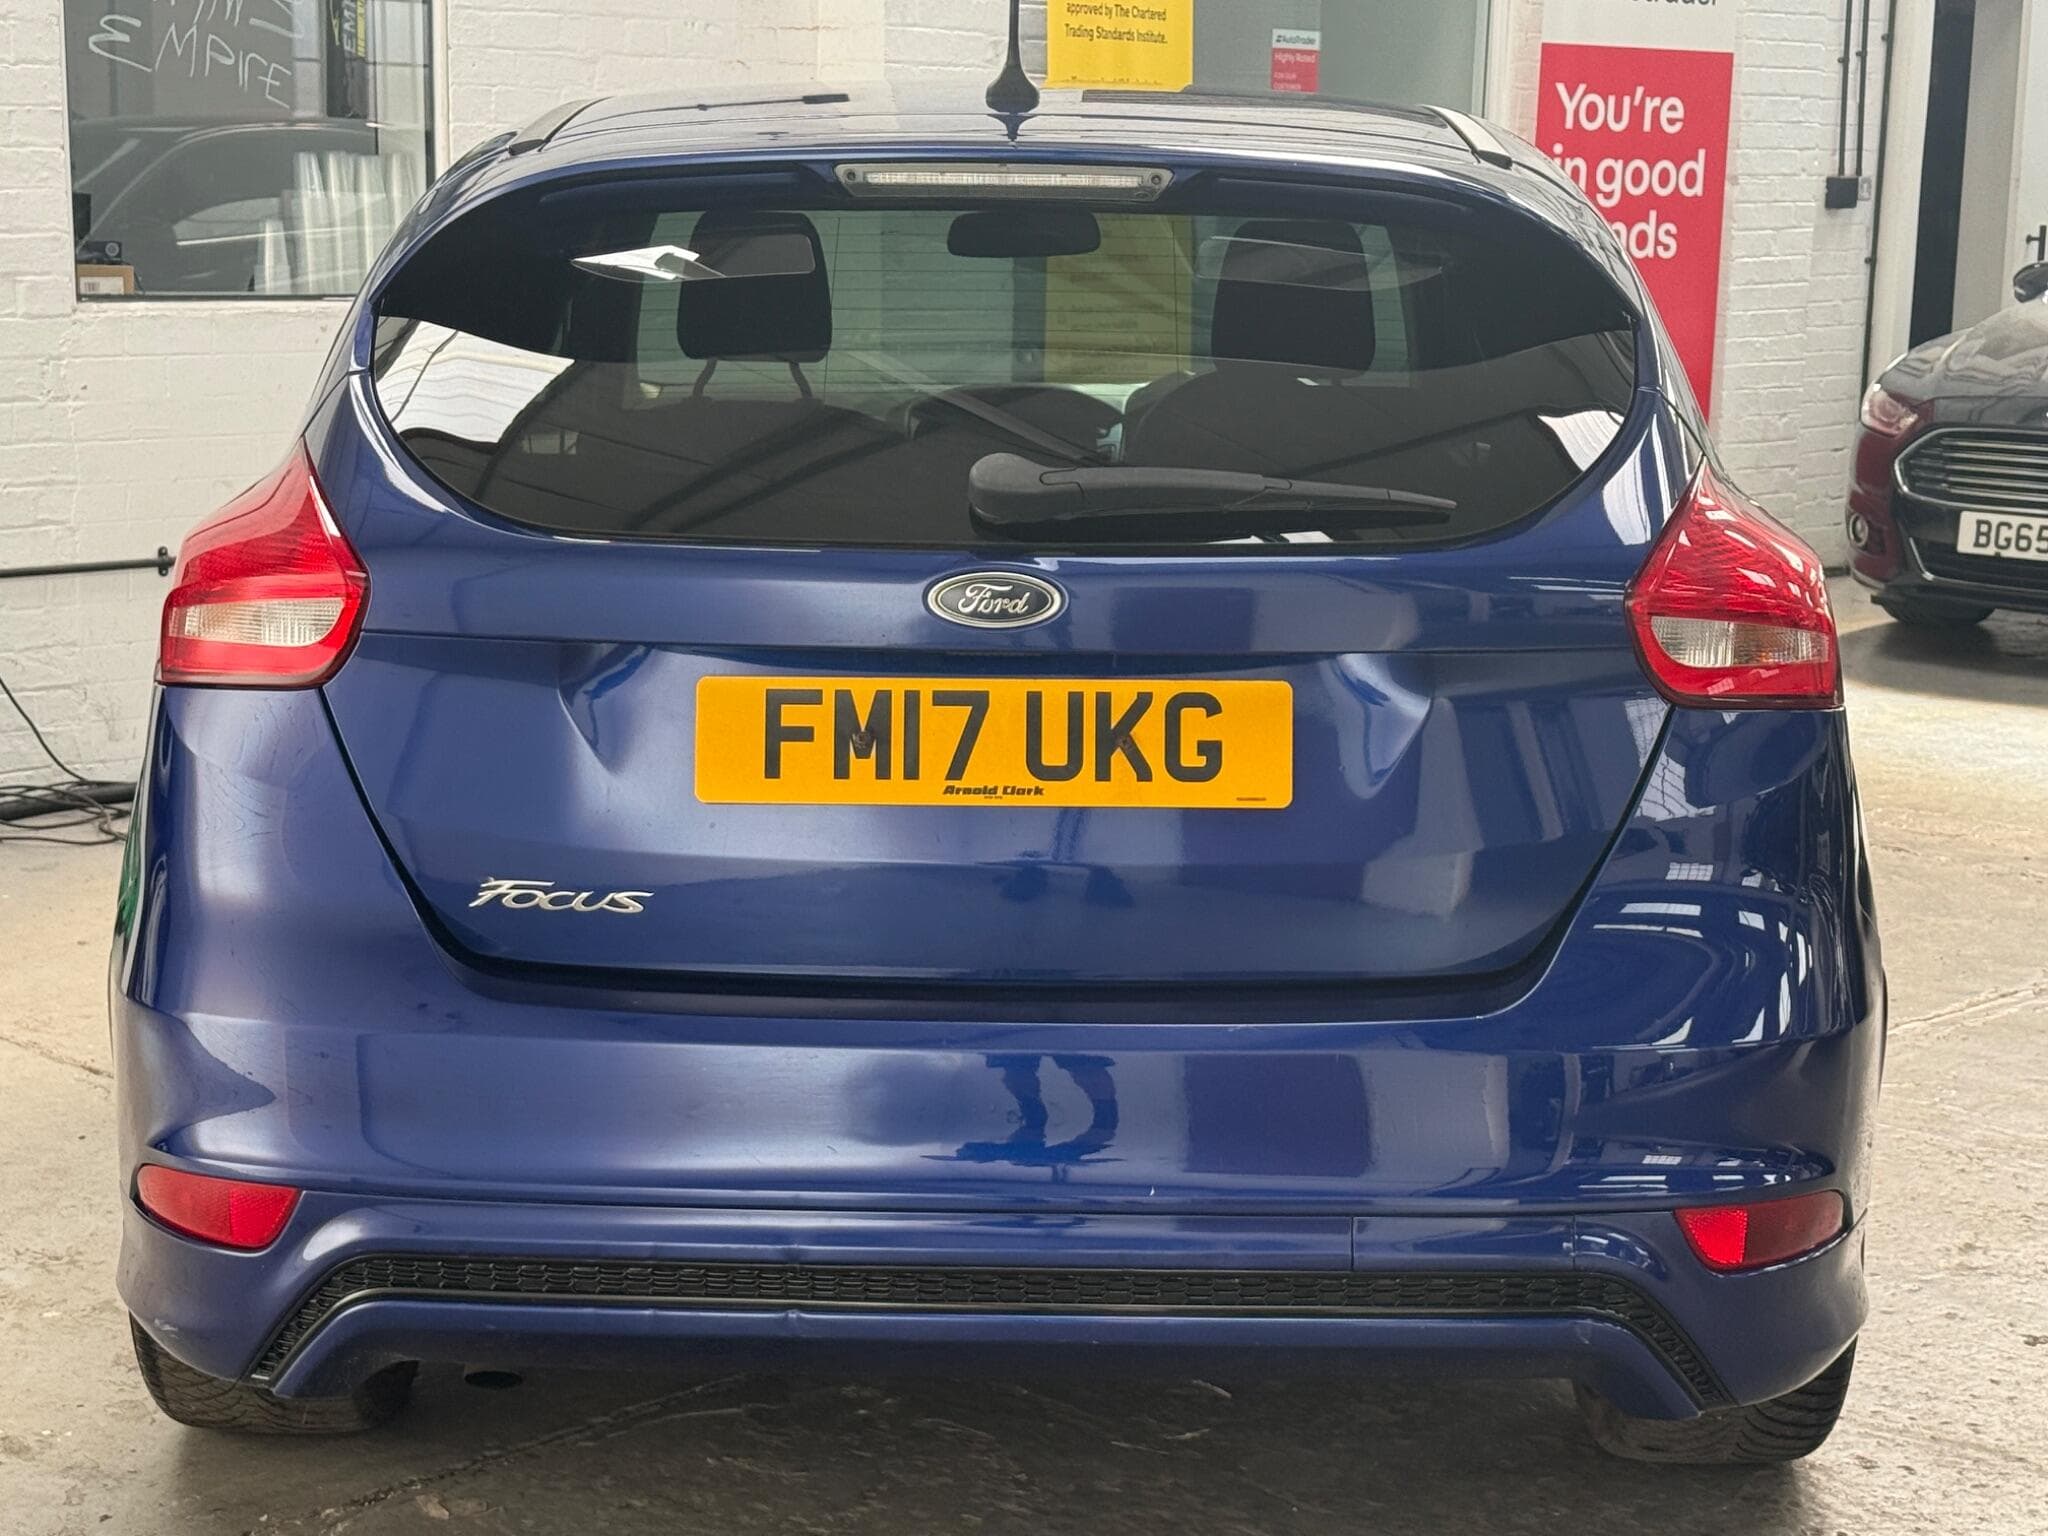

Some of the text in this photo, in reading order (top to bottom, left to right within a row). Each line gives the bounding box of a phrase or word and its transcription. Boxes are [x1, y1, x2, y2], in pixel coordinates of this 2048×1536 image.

[1066, 2, 1167, 21] approved by The Chartered
[1064, 23, 1095, 42] Trading
[1096, 26, 1136, 42] Standards
[1554, 82, 1685, 134] You're
[1594, 148, 1706, 208] good
[1606, 209, 1678, 260] nds
[957, 583, 1031, 614] Ford
[763, 688, 1224, 783] FM17 UKG
[942, 784, 1045, 796] Arnold Clark
